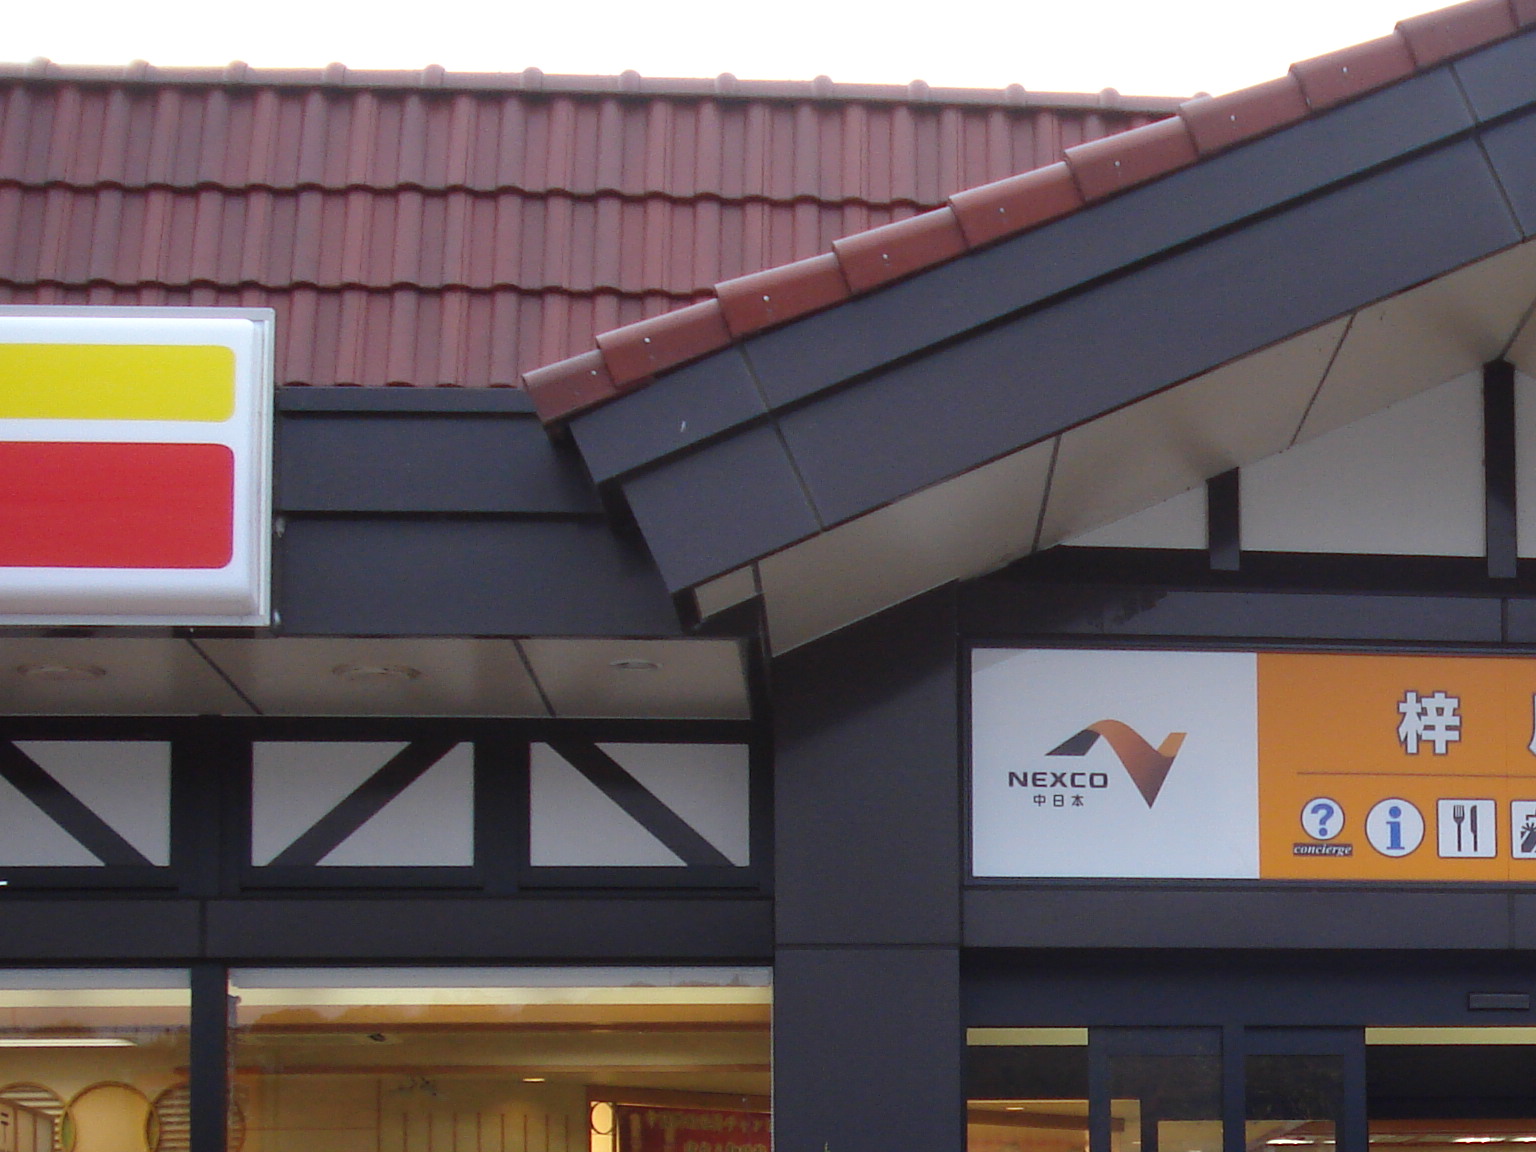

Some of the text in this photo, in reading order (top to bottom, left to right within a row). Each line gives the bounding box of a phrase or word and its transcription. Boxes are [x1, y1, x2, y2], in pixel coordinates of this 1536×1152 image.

[1008, 772, 1109, 788] NEXCO
[1033, 794, 1085, 807] 中日本
[1293, 844, 1353, 857] concierge
